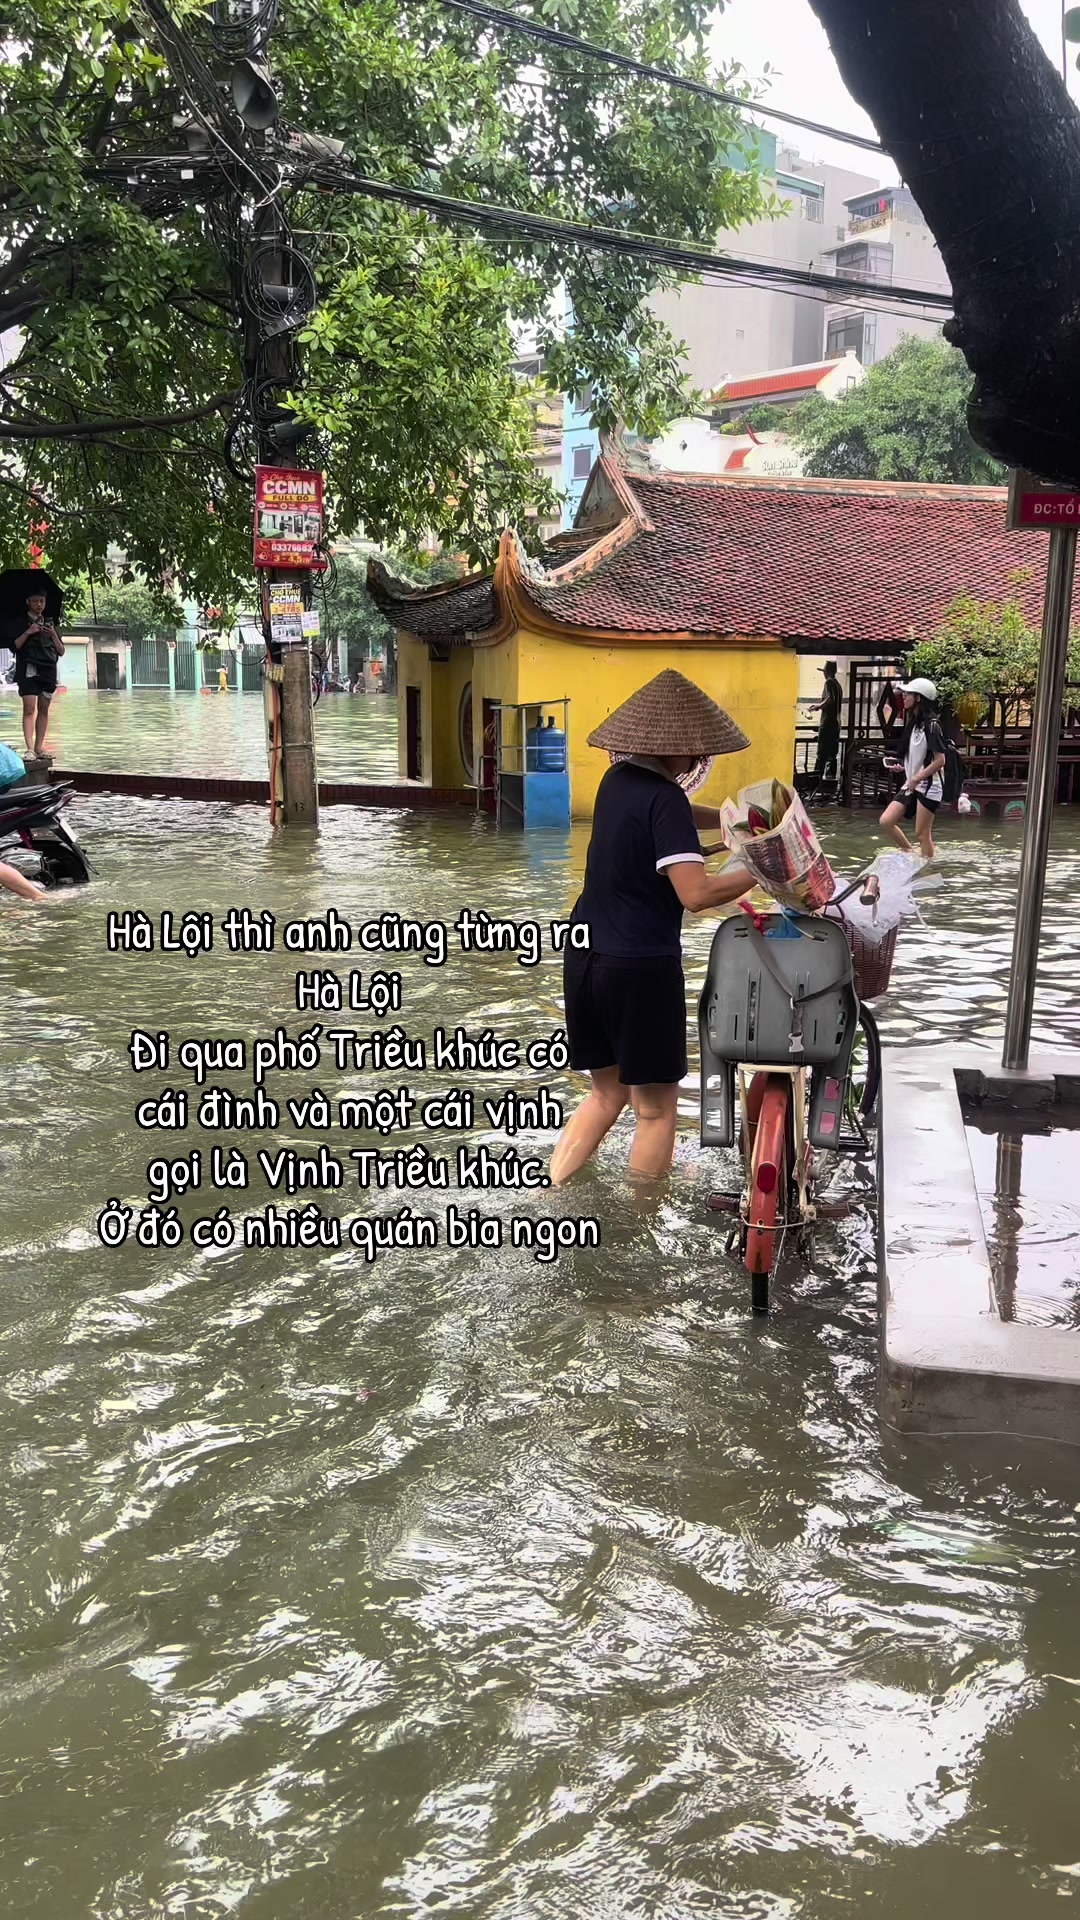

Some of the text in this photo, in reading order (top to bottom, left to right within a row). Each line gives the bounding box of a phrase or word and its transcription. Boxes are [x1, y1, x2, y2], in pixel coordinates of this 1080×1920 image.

[263, 480, 316, 495] CCMN
[273, 554, 280, 562] 3
[273, 595, 301, 604] CCMN
